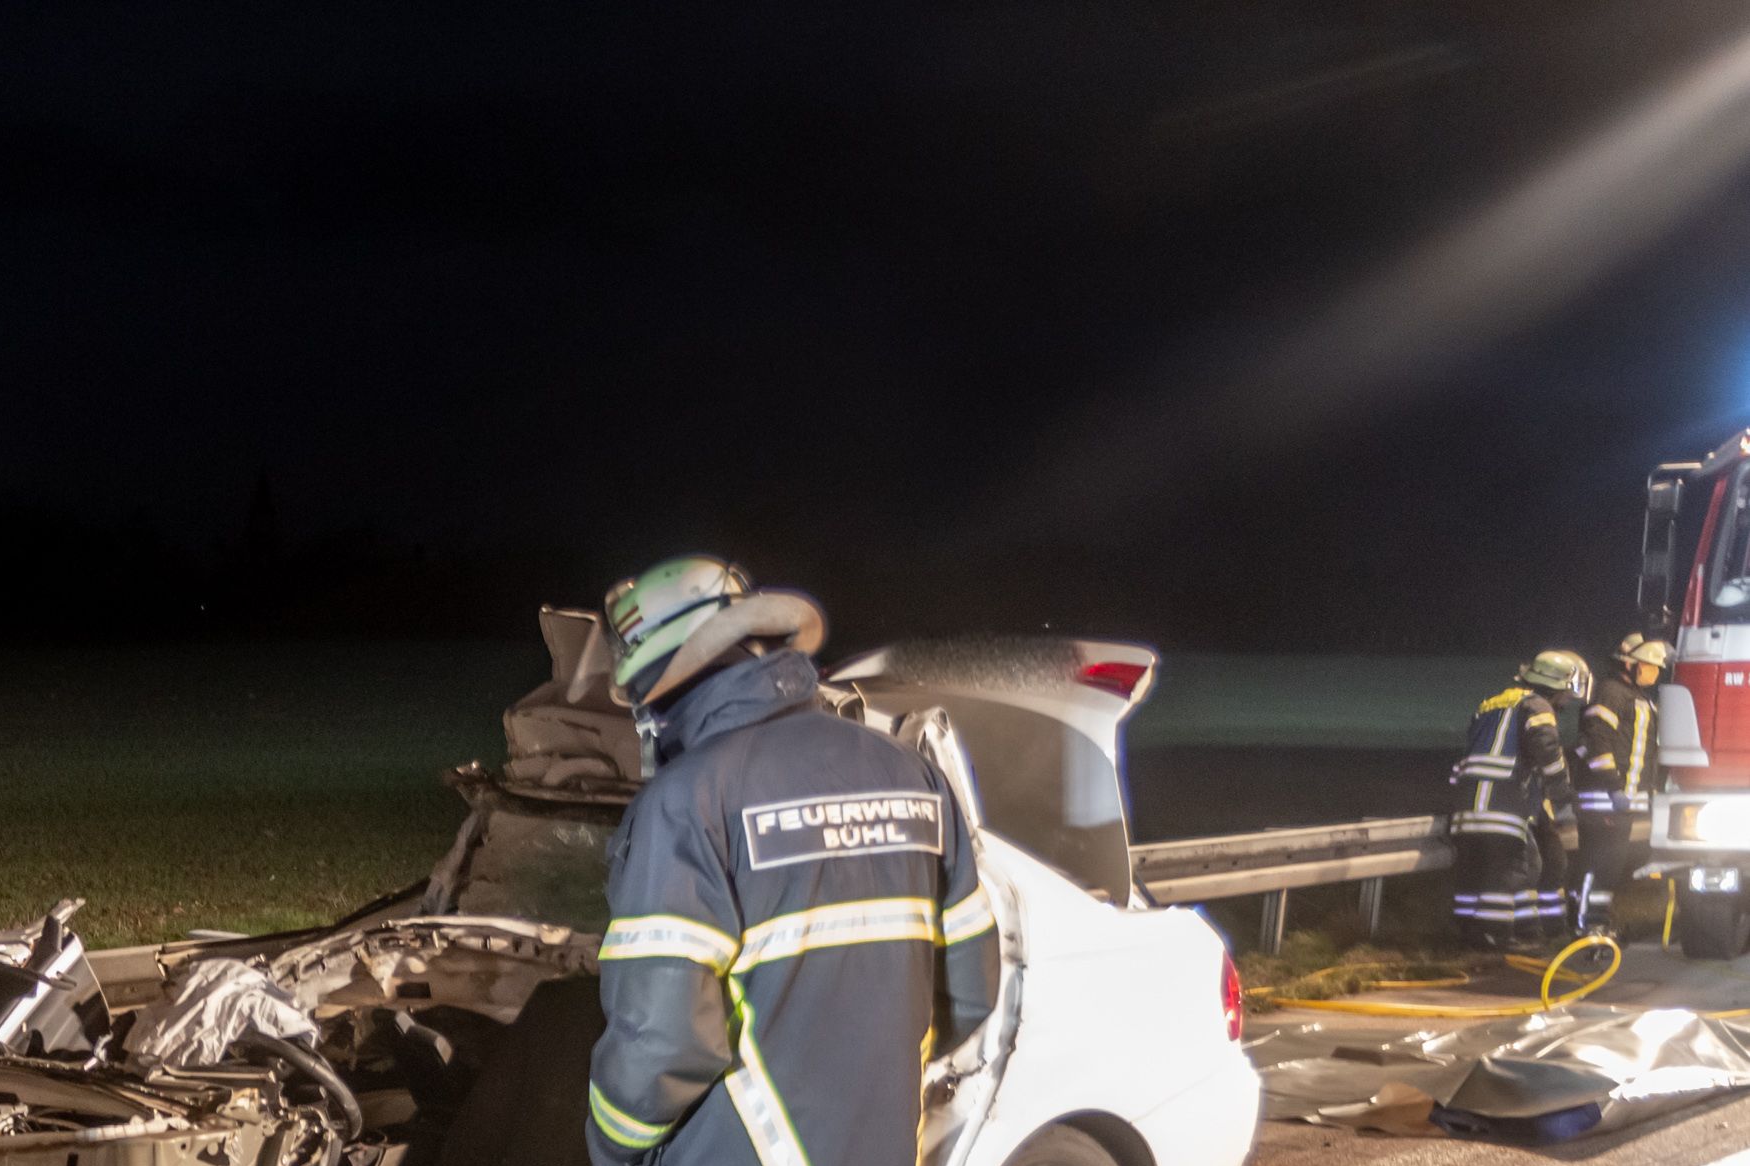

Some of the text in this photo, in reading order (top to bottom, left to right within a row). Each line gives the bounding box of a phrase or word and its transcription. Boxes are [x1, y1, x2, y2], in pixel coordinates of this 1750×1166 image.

[1725, 672, 1744, 686] RW
[756, 800, 935, 835] FEUERWEHR
[823, 823, 906, 849] BÜHL
